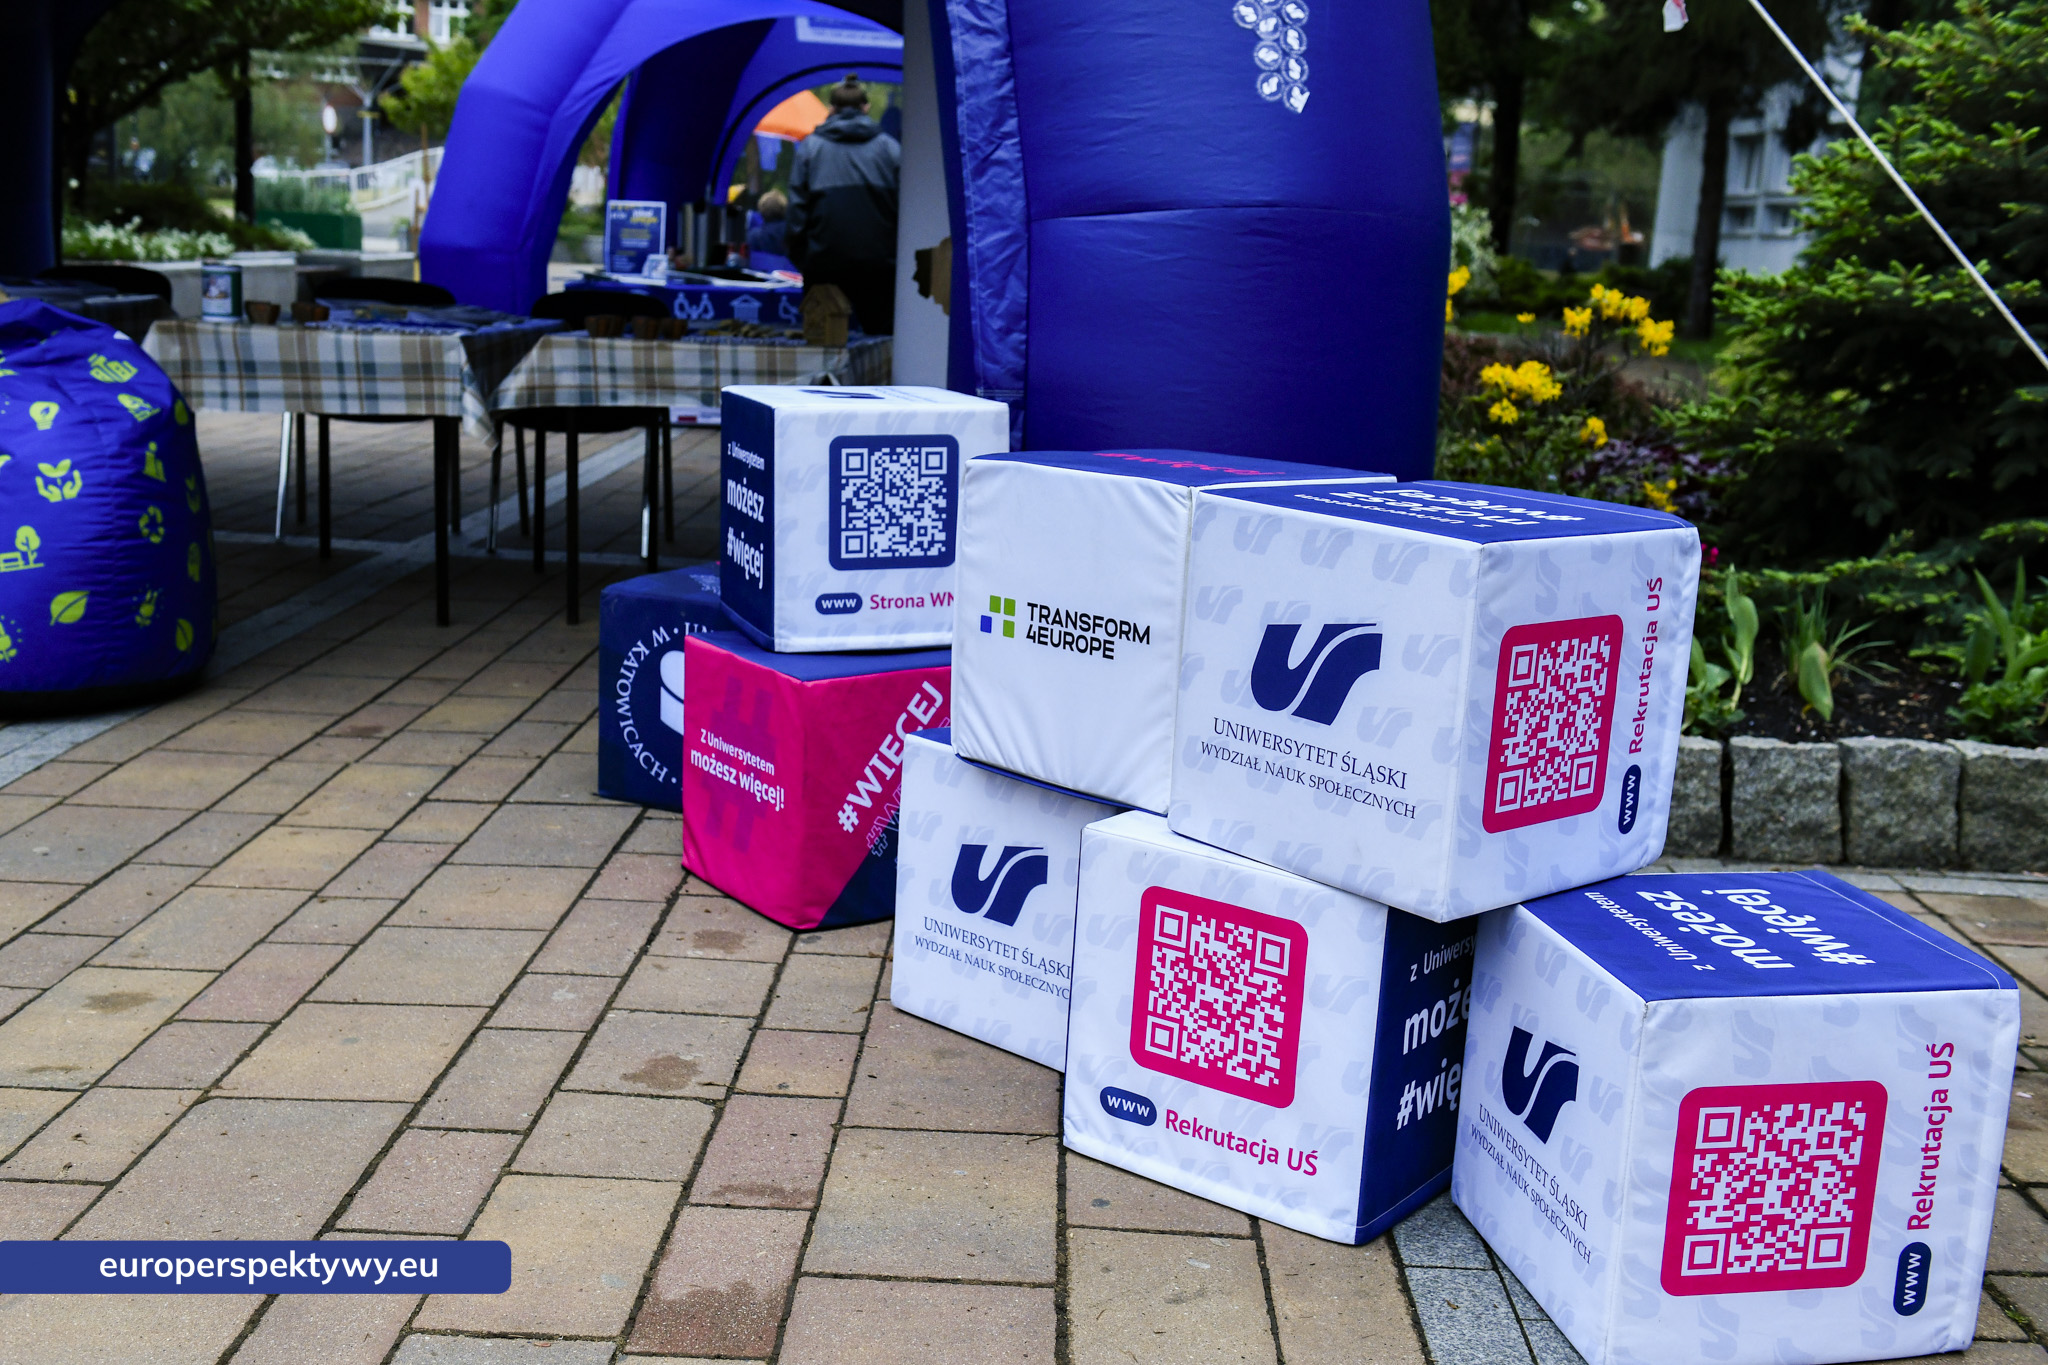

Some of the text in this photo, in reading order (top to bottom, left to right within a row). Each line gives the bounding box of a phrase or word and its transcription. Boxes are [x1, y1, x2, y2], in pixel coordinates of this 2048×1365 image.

[727, 477, 764, 523] możesz
[1329, 491, 1540, 526] możesz
[1373, 489, 1585, 522] #więcej
[727, 526, 764, 589] #więcej
[821, 598, 857, 609] www
[870, 594, 925, 610] Strona
[1027, 602, 1150, 645] TRANSFORM
[1026, 624, 1115, 660] 4EUROPE
[616, 626, 671, 783] W KATOWICACH
[1623, 576, 1663, 825] www Rekrutacja UŚ
[691, 749, 784, 812] możesz więcej!
[708, 731, 775, 776] Uniwersytetem
[1201, 741, 1416, 819] WYDZIAŁ NAUK SPOŁECZNYCH
[1213, 717, 1408, 790] UNIWERSYTET ŚLĄSKI
[915, 935, 962, 962] WYDZIAŁ
[964, 952, 996, 974] NAUK
[924, 916, 1071, 980] UNIWERSYTET ŚLĄSKI
[1584, 891, 1698, 961] Uniwersytetem
[1635, 890, 1796, 969] możesz
[1701, 888, 1876, 965] #więcej
[1410, 963, 1418, 982] z
[1106, 1094, 1319, 1177] www Rekrutacja UŚ
[1479, 1103, 1549, 1188] UNIWERSYTET
[1550, 1175, 1588, 1232] ŚLĄSKI
[1471, 1123, 1592, 1264] WYDZIAŁ NAUK SPOŁECZNYCH
[1902, 1042, 1955, 1306] www Rekrutacja UŚ
